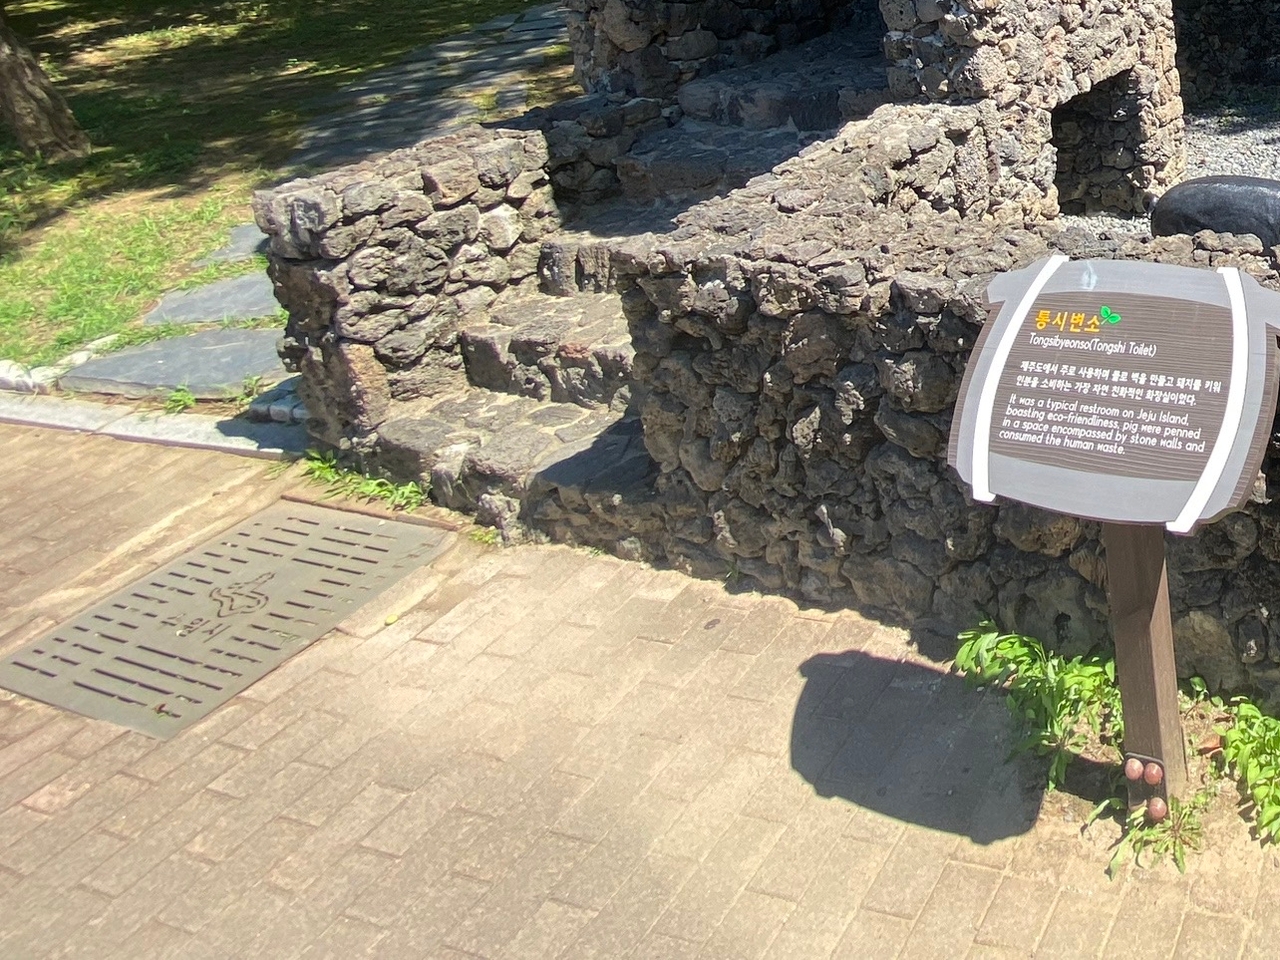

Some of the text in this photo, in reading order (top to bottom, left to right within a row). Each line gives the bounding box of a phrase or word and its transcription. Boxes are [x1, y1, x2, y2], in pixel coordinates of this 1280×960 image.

[1035, 310, 1100, 332] 통시변소
[1029, 333, 1157, 357] Tongsibyeonso(Tongshi Toilet)
[1016, 375, 1196, 406] 인분을 소비하는 가장 자연 친화적인 화장실이었다.
[1020, 361, 1221, 393] 제주도에서 주로 사용하며 돌로 벽을 만들고 돼지를 키워
[1006, 405, 1045, 420] boasting
[1122, 420, 1138, 433] pig
[1141, 424, 1162, 434] were
[1163, 427, 1202, 439] penned
[1009, 393, 1017, 404] It
[1019, 397, 1035, 406] was
[1037, 399, 1045, 407] a
[1046, 398, 1078, 411] typical
[1079, 403, 1119, 417] restroom
[1122, 409, 1134, 418] on
[1137, 408, 1157, 422] Jeju
[999, 430, 1125, 455] consumed the human waste.
[1002, 416, 1206, 452] in a space encompassed by stone walls and
